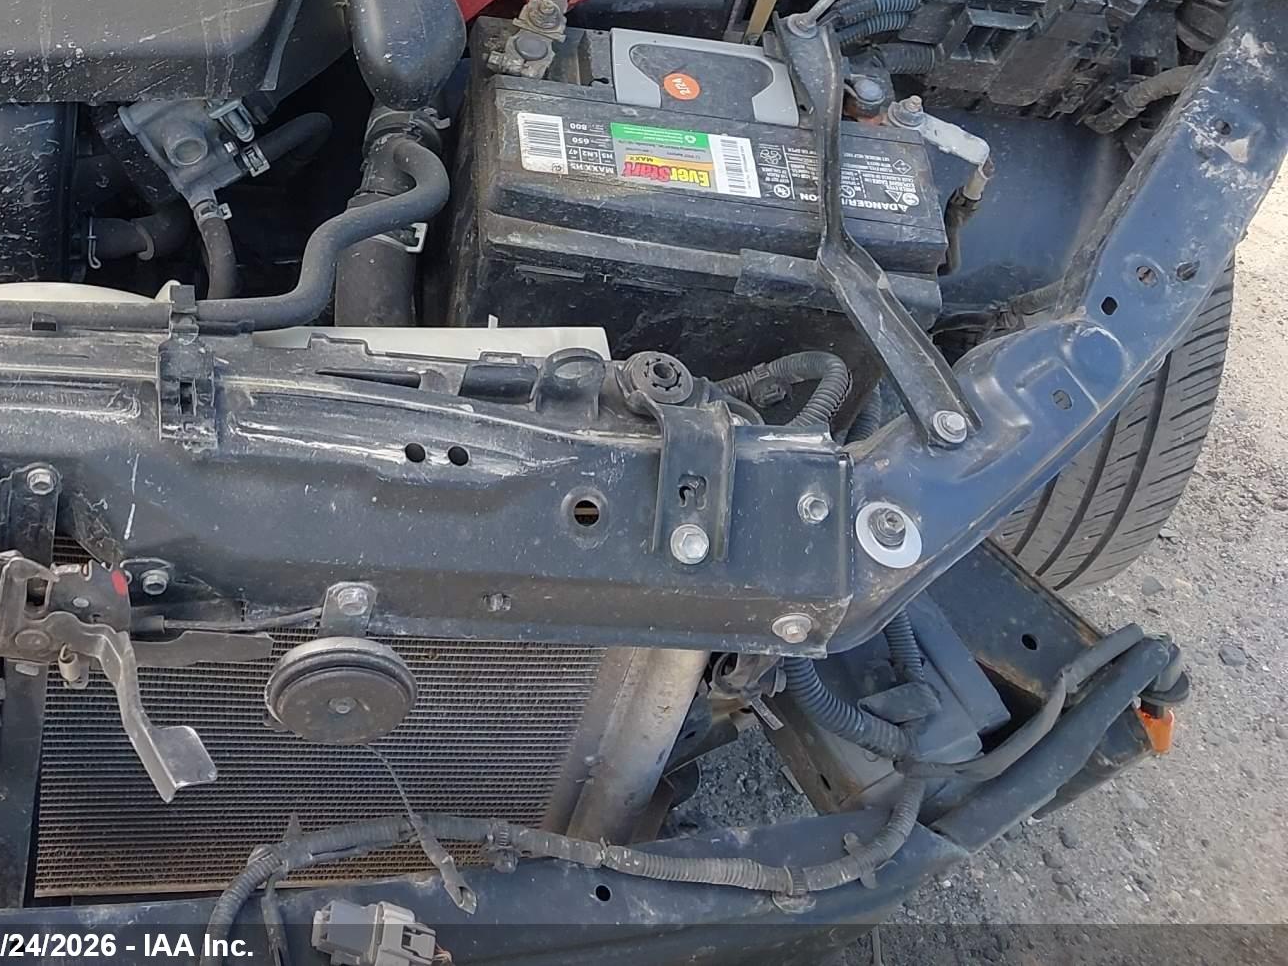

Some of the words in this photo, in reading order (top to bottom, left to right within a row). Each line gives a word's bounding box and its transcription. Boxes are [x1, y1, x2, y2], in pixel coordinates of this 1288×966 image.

[570, 122, 588, 131] 800
[571, 137, 590, 145] 650
[568, 148, 578, 156] 47
[622, 162, 711, 188] EverStart
